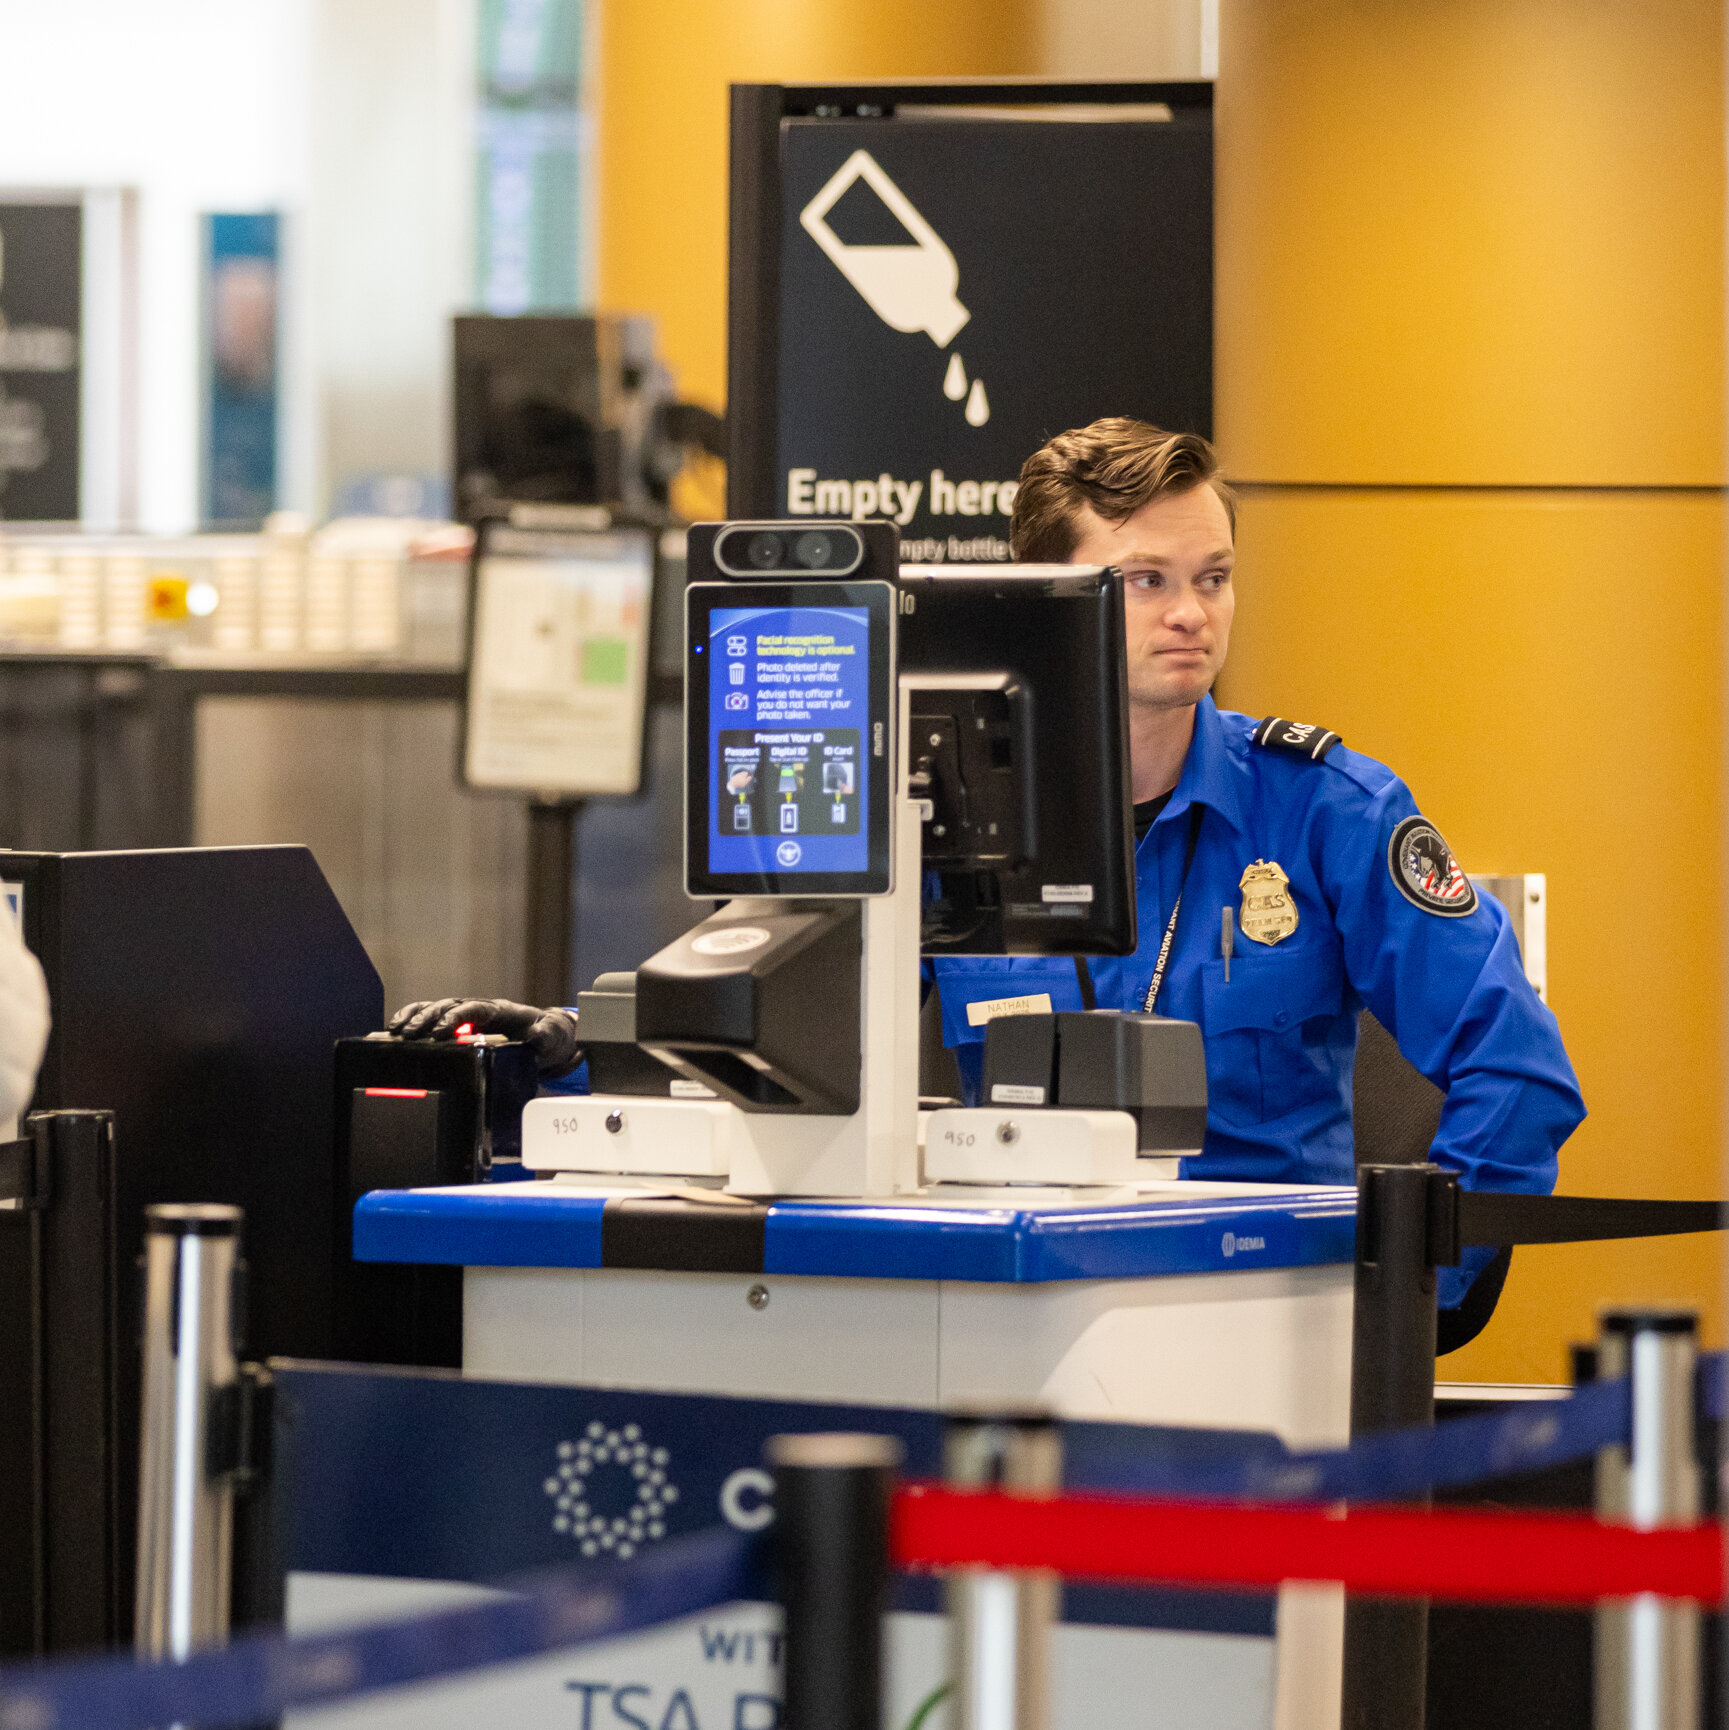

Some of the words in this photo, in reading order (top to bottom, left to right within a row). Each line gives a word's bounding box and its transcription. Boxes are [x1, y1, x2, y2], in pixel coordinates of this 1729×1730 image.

[787, 467, 923, 525] Empty
[930, 468, 1019, 516] here
[899, 537, 947, 563] mpty
[900, 590, 916, 615] lo
[757, 636, 783, 645] Facial
[784, 636, 834, 647] recognition
[757, 645, 806, 657] technology
[809, 646, 815, 655] is
[817, 646, 855, 656] optional.
[757, 662, 783, 672] Photo
[785, 662, 817, 672] deleted
[819, 662, 840, 672] after
[757, 672, 792, 684] identity
[794, 672, 801, 682] is
[803, 672, 840, 682] verified.
[757, 690, 787, 699] Advise
[789, 689, 803, 699] the
[805, 689, 834, 699] officer
[836, 689, 843, 699] if
[757, 701, 774, 710] you
[775, 700, 787, 709] do
[789, 700, 804, 709] not
[806, 700, 829, 709] want
[830, 700, 851, 710] your
[757, 710, 783, 721] photo
[785, 710, 811, 720] taken.
[754, 733, 790, 743] Present
[791, 733, 811, 743] Your
[813, 733, 824, 743] ID
[1283, 722, 1317, 744] CAS
[724, 747, 760, 757] Passport
[771, 746, 795, 757] Digital
[796, 746, 808, 756] ID
[824, 746, 833, 756] ID
[834, 746, 853, 756] Card
[1154, 930, 1175, 971] AVIATION
[1143, 970, 1162, 1013] SECURIT
[987, 999, 1030, 1013] NATHAN
[552, 1118, 578, 1135] 950
[944, 1131, 976, 1147] 950
[1236, 1236, 1266, 1251] IDEMIA
[700, 1625, 784, 1666] WIT
[565, 1681, 700, 1730] TSA
